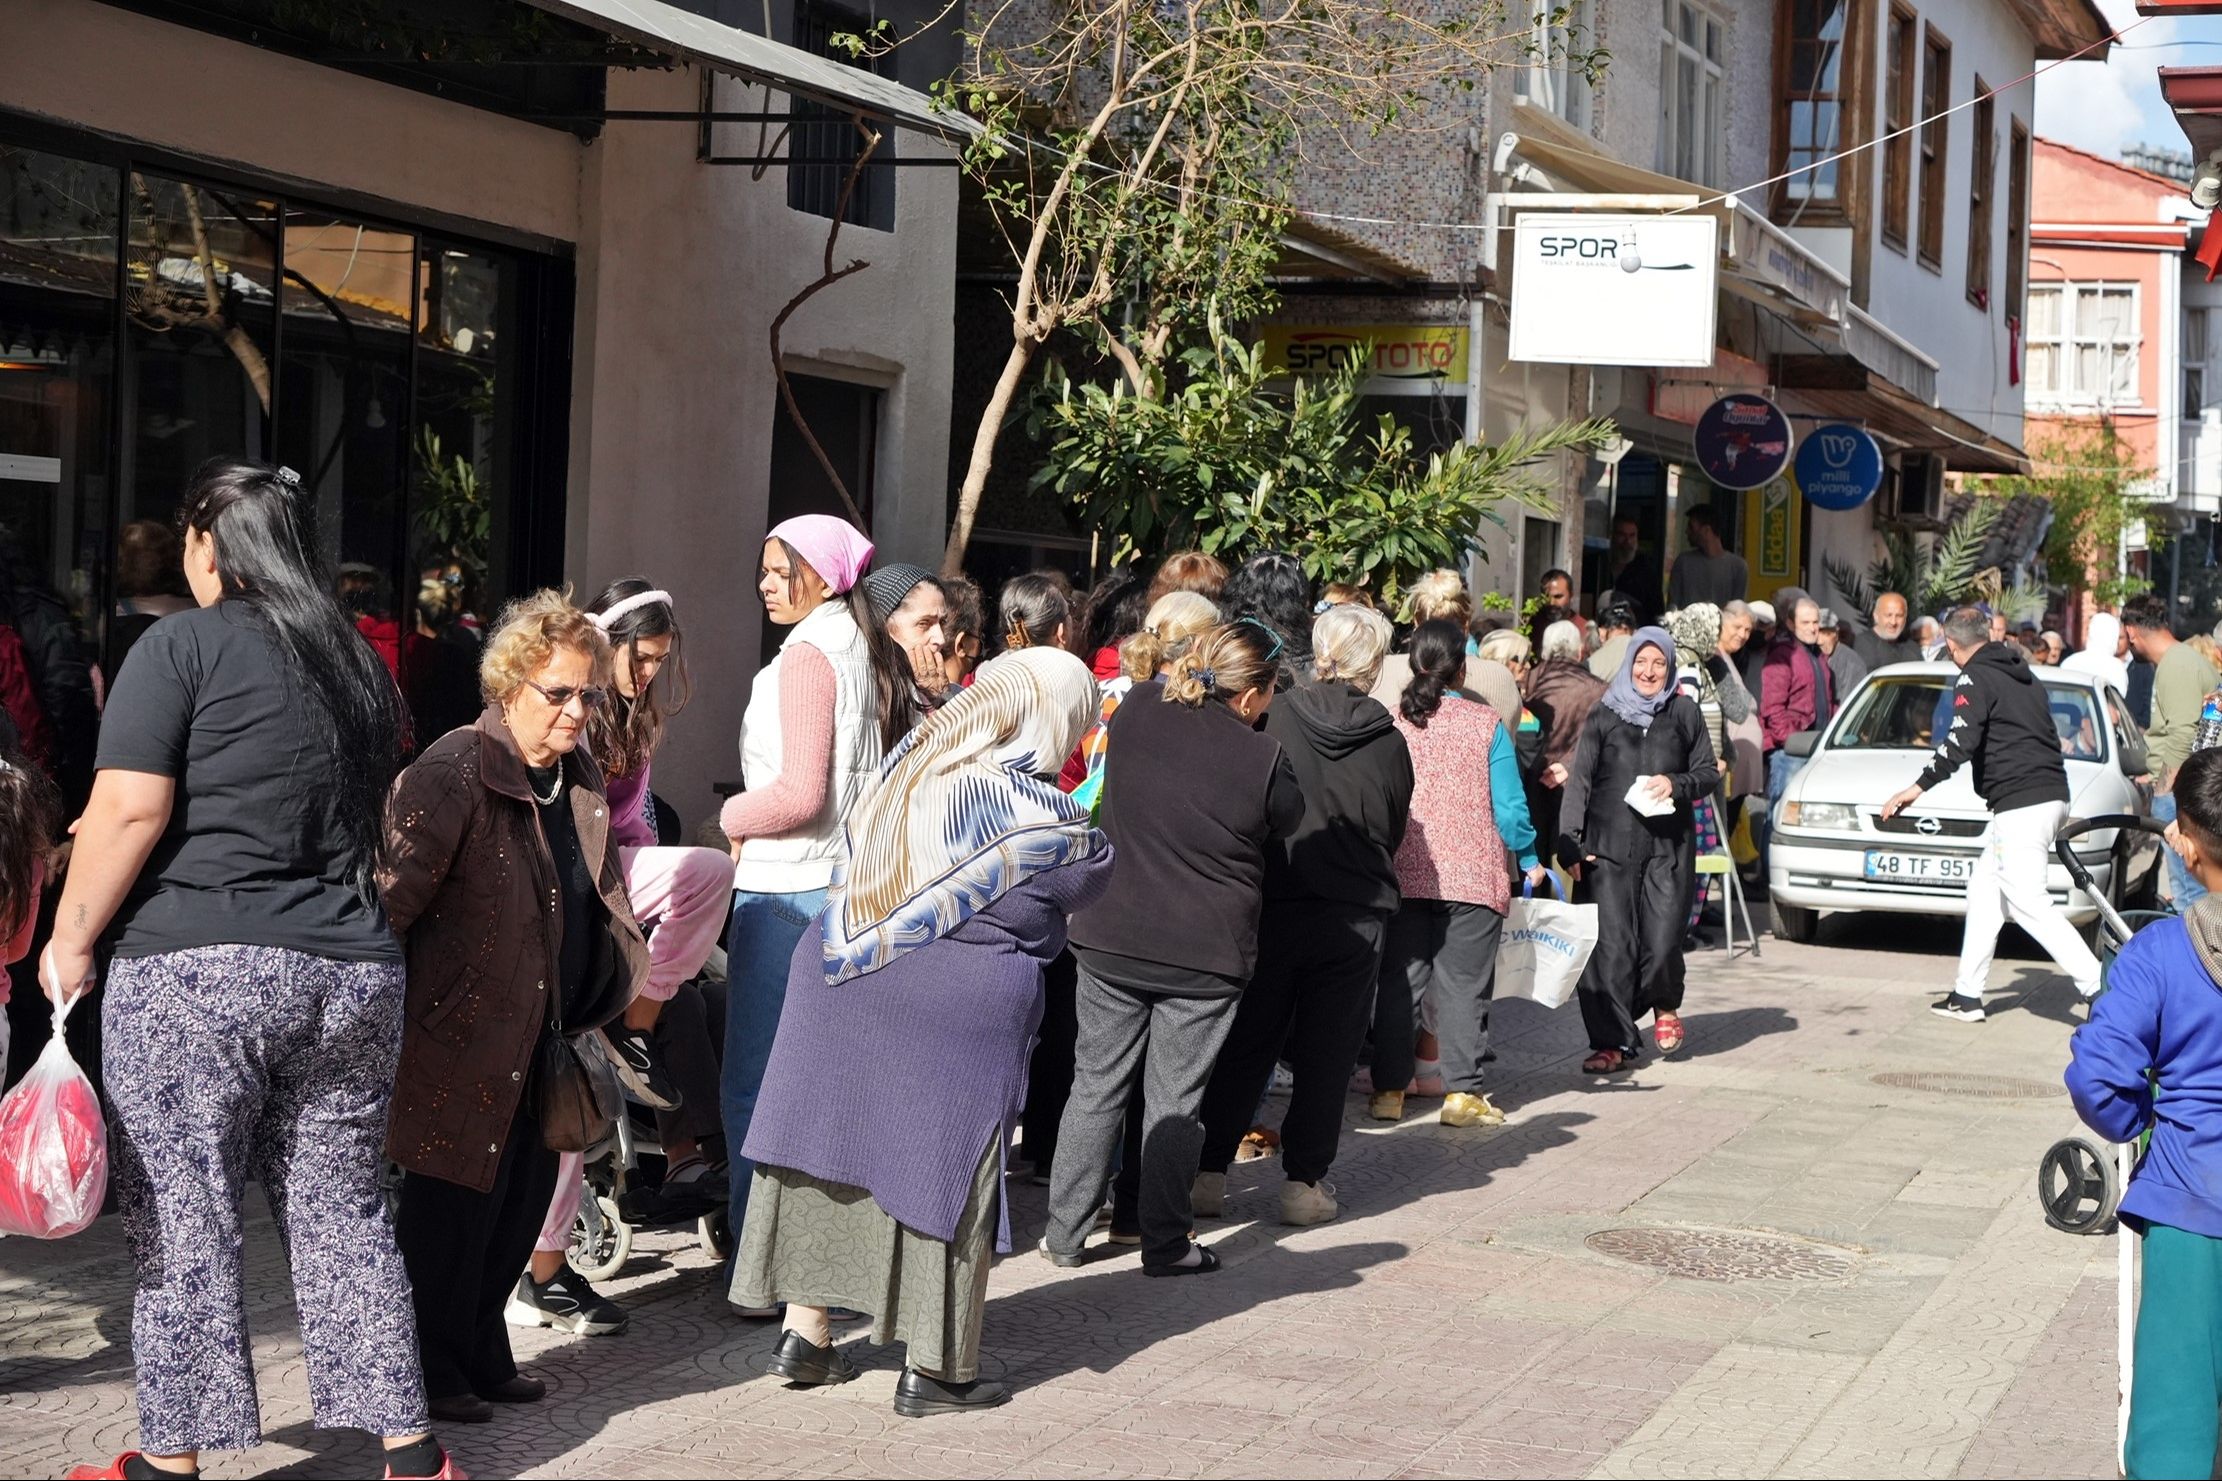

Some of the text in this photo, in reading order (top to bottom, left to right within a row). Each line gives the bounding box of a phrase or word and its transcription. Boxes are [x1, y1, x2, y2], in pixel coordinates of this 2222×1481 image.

[1540, 237, 1618, 259] SPOR
[1375, 342, 1453, 369] TOTO
[1821, 470, 1850, 482] milli
[1808, 481, 1862, 496] piyango
[1766, 508, 1785, 570] iddaa
[1877, 855, 1974, 877] 48 TF 951
